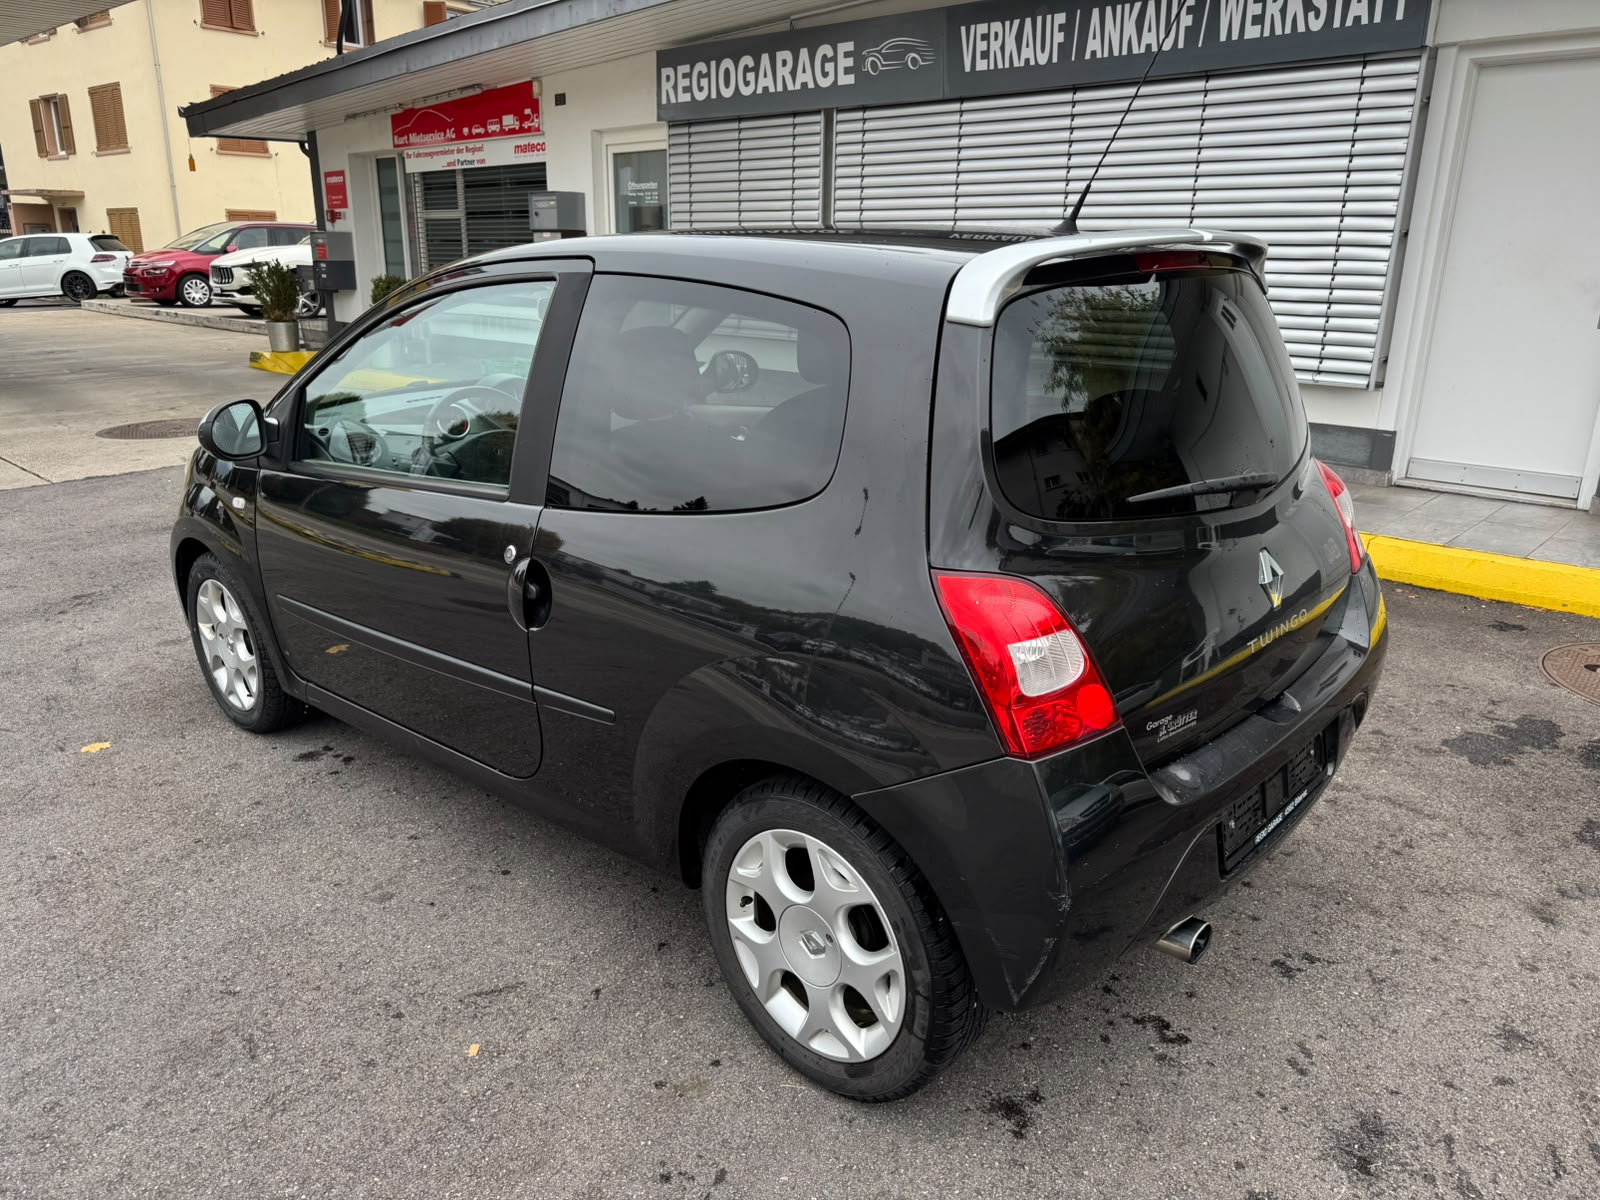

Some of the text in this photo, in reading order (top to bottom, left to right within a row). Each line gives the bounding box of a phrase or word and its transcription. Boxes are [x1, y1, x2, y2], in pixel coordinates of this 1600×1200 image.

[960, 12, 1066, 72] VERKAUF
[1084, 0, 1195, 60] ANKAUF
[661, 41, 855, 104] REGIOGARAGE
[394, 128, 456, 145] Kurt Mietservice AG
[456, 146, 464, 154] der
[514, 141, 546, 154] mateco
[457, 158, 475, 166] Partner
[1247, 608, 1307, 653] TWINGO
[1146, 714, 1173, 731] Garage
